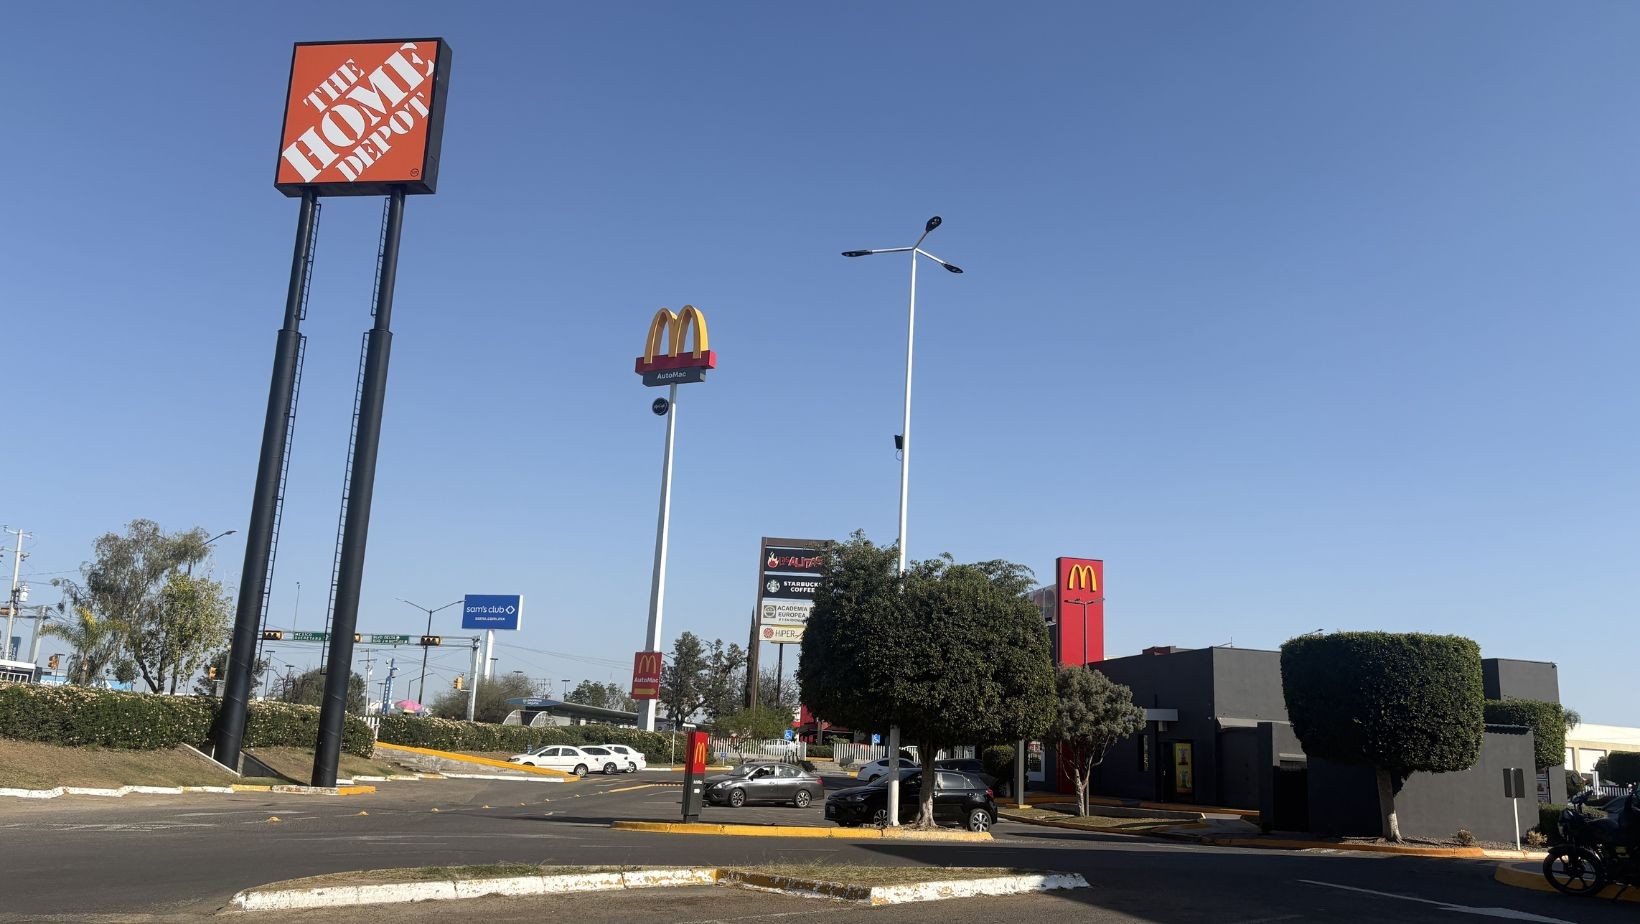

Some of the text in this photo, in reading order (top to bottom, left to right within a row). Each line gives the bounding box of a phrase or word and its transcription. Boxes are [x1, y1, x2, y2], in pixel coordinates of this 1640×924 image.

[281, 42, 435, 183] HOME
[302, 58, 366, 113] THE
[335, 91, 430, 182] DEPOT
[656, 371, 687, 380] AutoMac
[466, 605, 505, 614] sam's club
